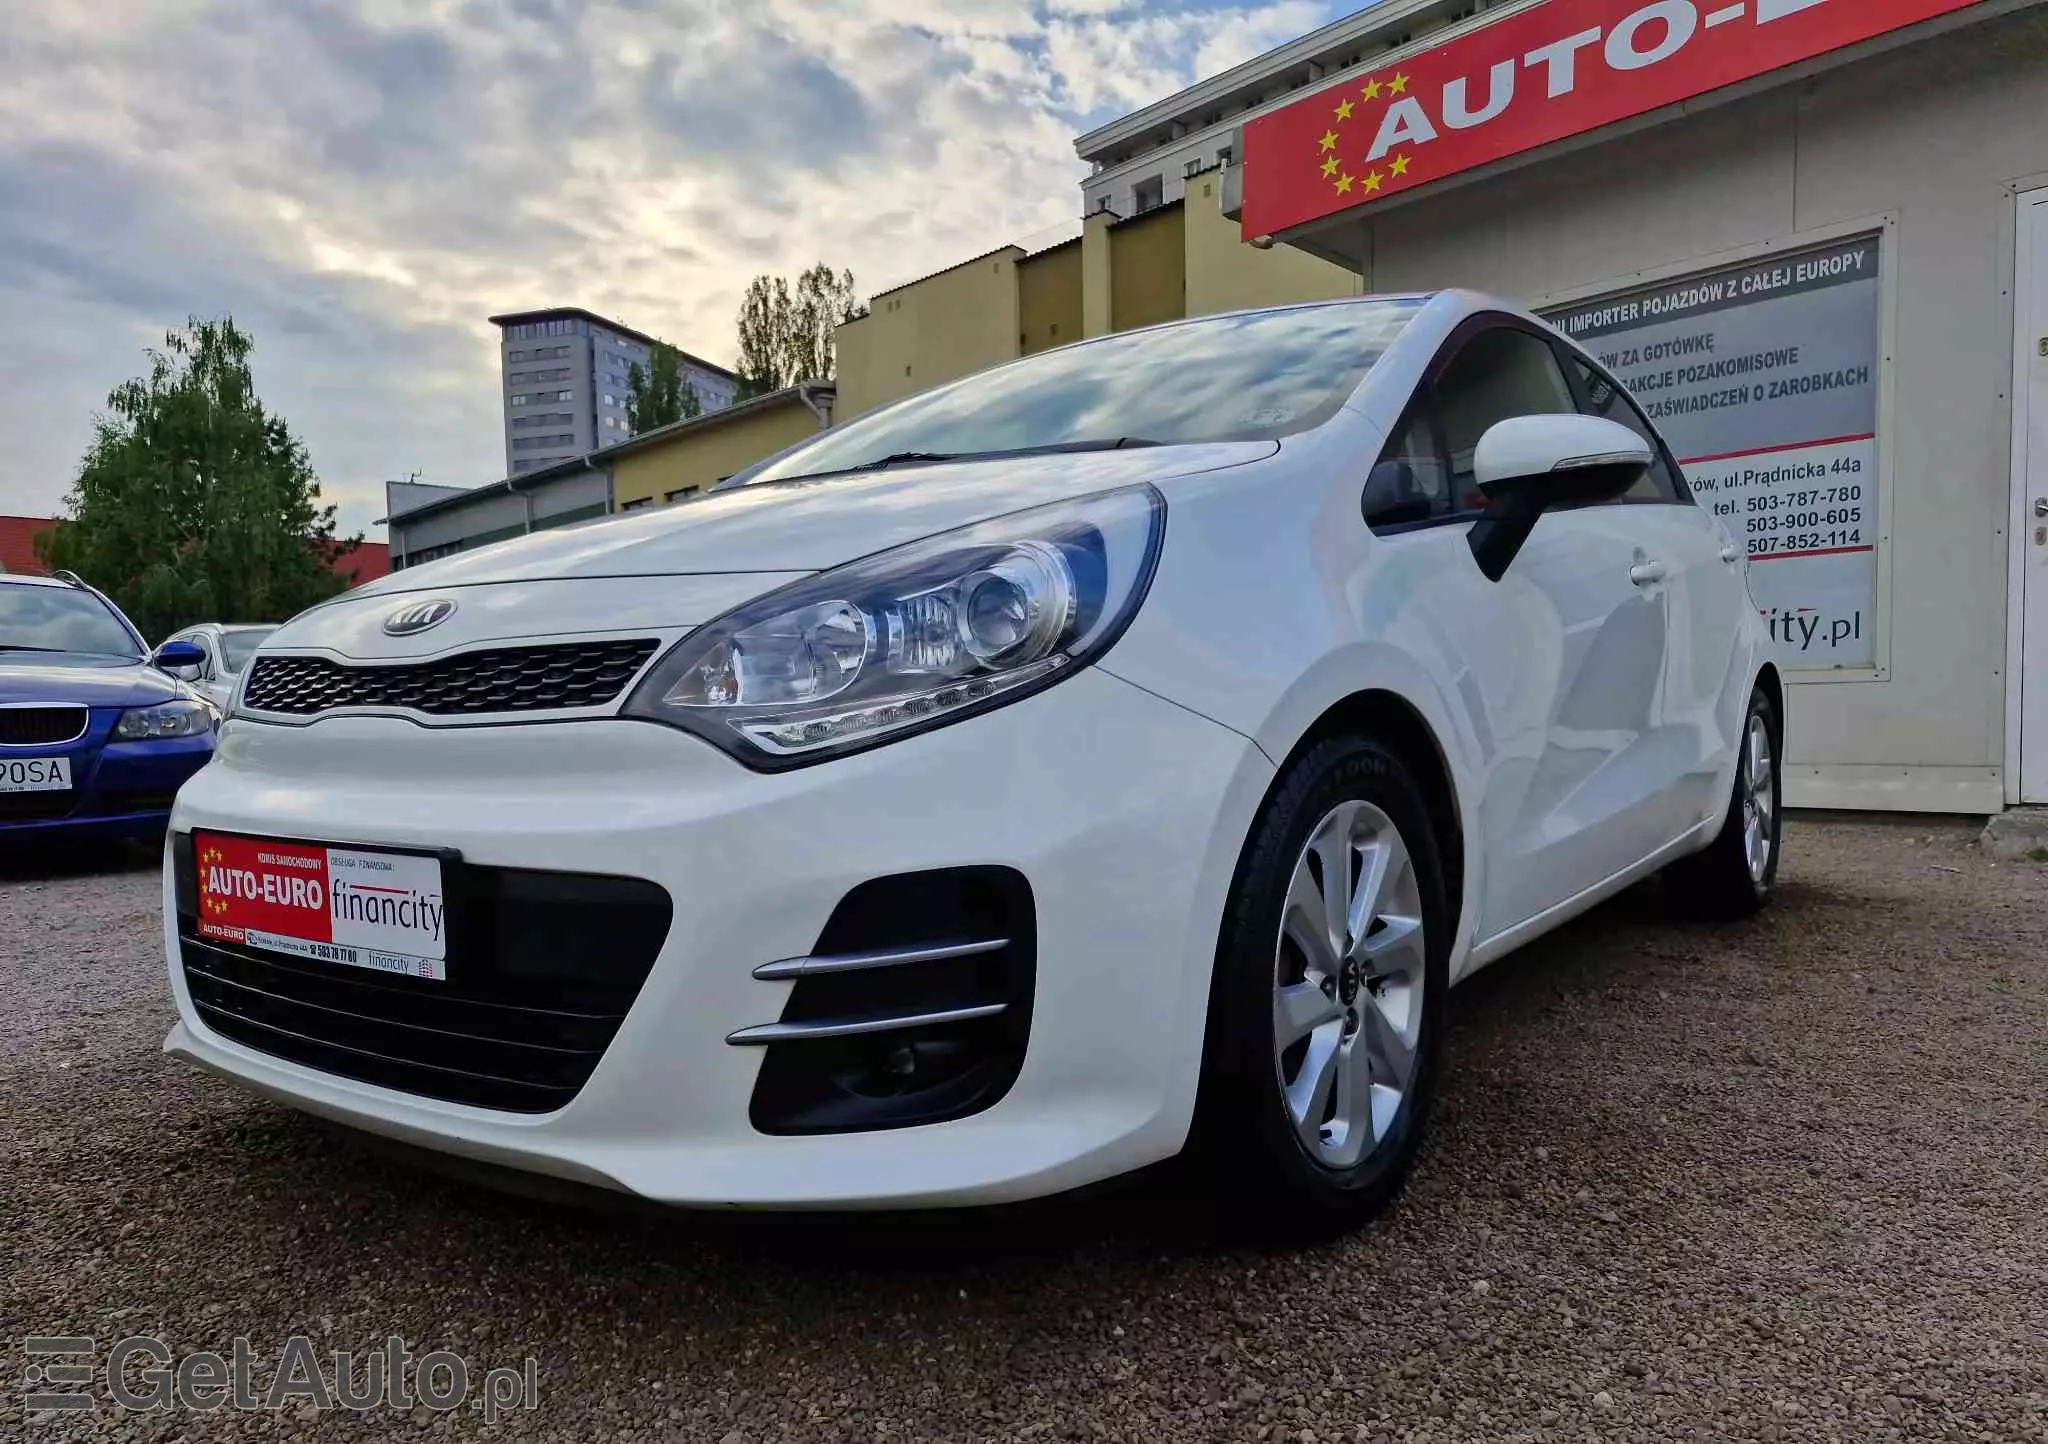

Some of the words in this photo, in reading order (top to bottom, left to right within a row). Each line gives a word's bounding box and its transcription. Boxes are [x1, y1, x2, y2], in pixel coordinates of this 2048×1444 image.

[1364, 0, 1829, 162] AUTO-
[1569, 303, 1639, 333] IMPORTER
[1642, 283, 1723, 317] POJAZDÓW
[1727, 279, 1737, 298] Z
[1741, 266, 1791, 295] CAŁEJ
[1796, 250, 1865, 283] EUROPY
[1621, 348, 1639, 367] ZA
[1643, 332, 1715, 362] GOTÓWKĘ
[1677, 346, 1799, 386] POZAKOMISOWE
[1646, 383, 1749, 418] ZAŚWIADCZEŃ
[1753, 384, 1765, 402] O
[1768, 365, 1869, 400] ZAROBKACH
[1831, 457, 1862, 474] 44a
[1713, 500, 1740, 516] tel.
[1746, 485, 1862, 512] 503-787-780
[1746, 507, 1862, 533] 503-900-605
[1747, 528, 1861, 554] 507-852-114
[387, 603, 441, 626] KIA
[208, 865, 323, 910] AUTO-EURO
[333, 878, 444, 941] financity
[203, 924, 245, 940] AUTO-EURO
[368, 950, 409, 975] financity
